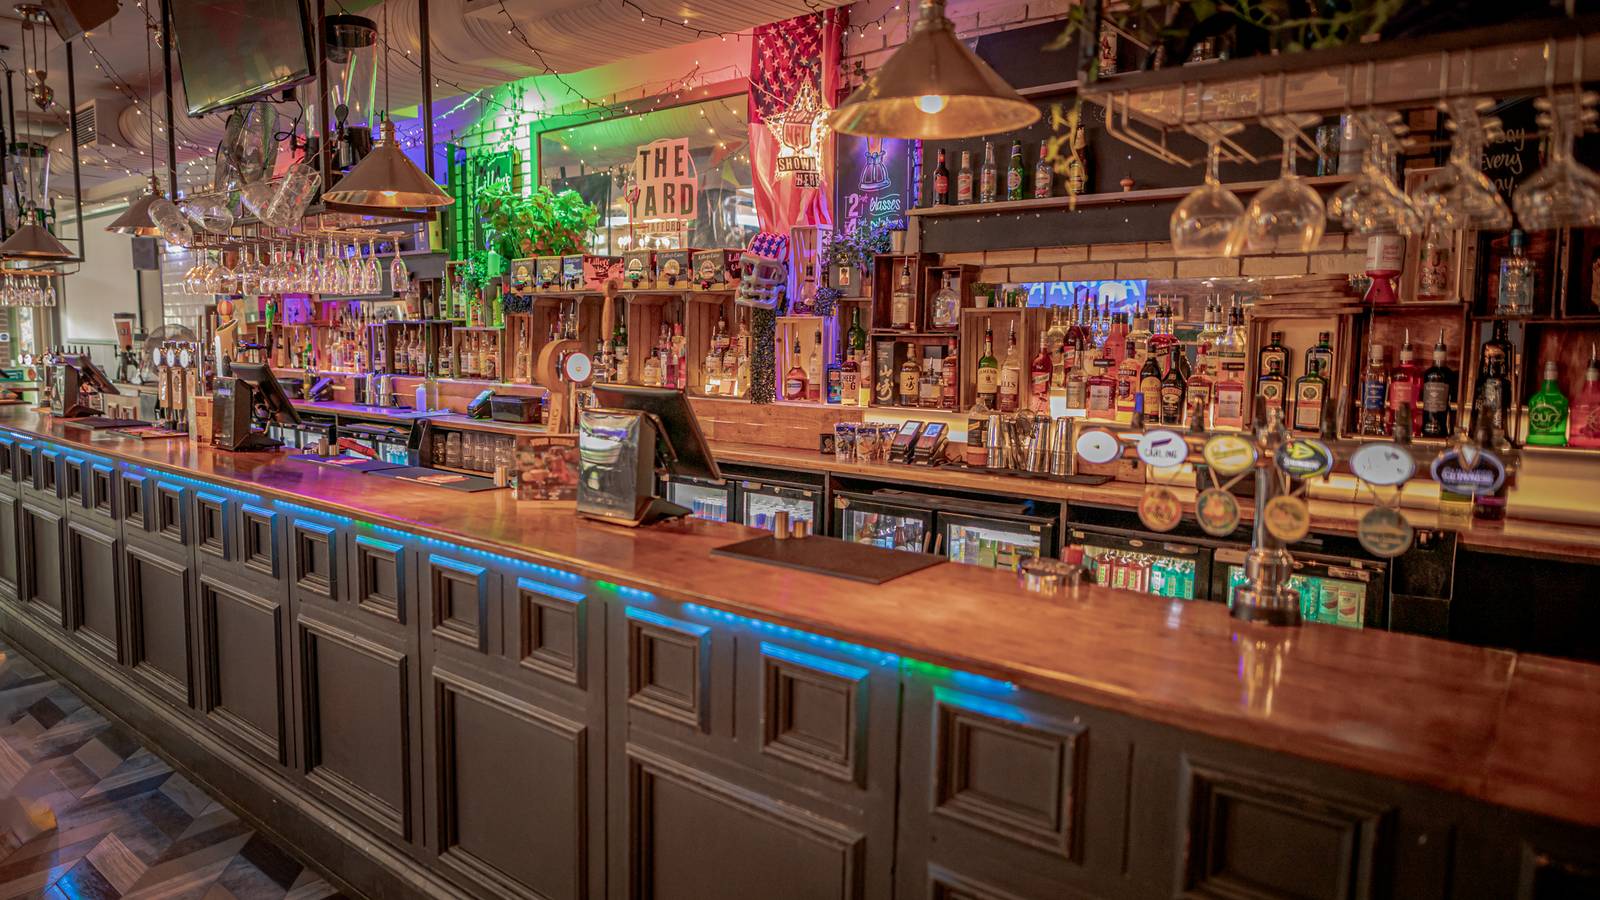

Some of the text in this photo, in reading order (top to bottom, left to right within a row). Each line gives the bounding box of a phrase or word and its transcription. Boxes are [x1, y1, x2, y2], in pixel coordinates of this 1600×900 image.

[640, 145, 684, 180] THE
[779, 157, 816, 171] SHOWN
[1481, 153, 1522, 174] Every
[796, 173, 820, 186] HERE
[1495, 176, 1518, 197] ay.
